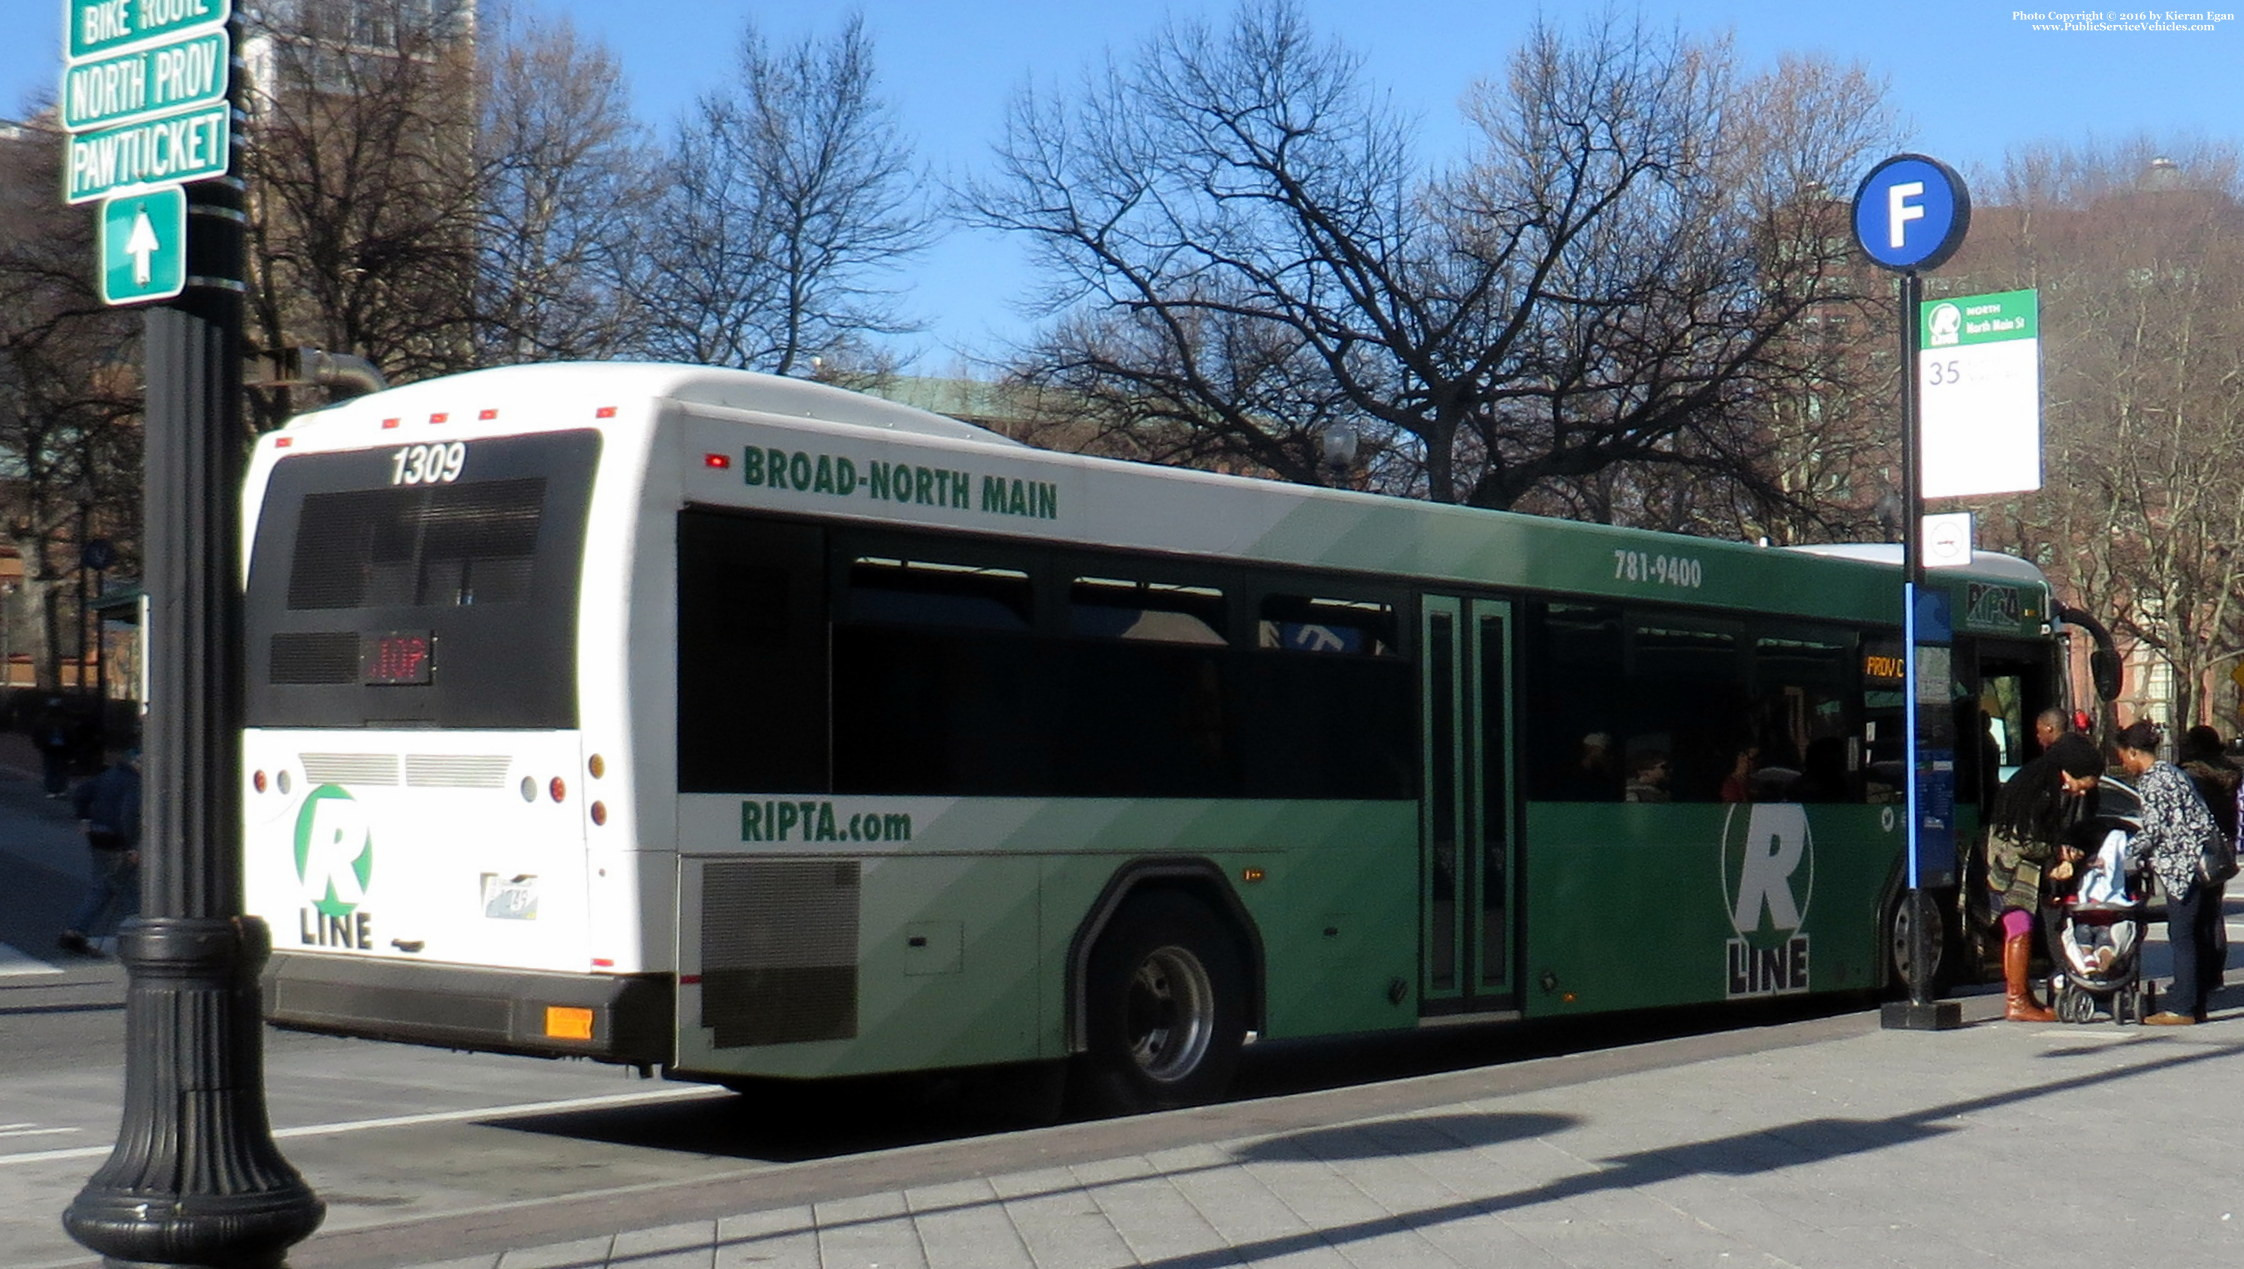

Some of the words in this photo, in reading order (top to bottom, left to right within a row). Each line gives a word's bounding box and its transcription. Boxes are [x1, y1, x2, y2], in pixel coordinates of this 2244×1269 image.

[83, 0, 132, 45] BIKE
[71, 57, 146, 121] NORTH
[156, 40, 217, 103] PROV
[73, 113, 223, 193] PAWTUCKET
[1889, 181, 1924, 248] F
[1966, 304, 2001, 316] NORTH
[1966, 321, 1991, 334] North
[1929, 360, 1960, 386] 35
[391, 442, 466, 486] 1309
[744, 445, 970, 509] BROAD-NORTH
[981, 475, 1057, 520] MAIN
[1614, 550, 1702, 588] 781-9400
[741, 800, 912, 842] RIPTA.com
[302, 797, 370, 904] R
[1735, 803, 1805, 933] R
[300, 906, 373, 949] LINE
[1727, 934, 1810, 999] LINE
